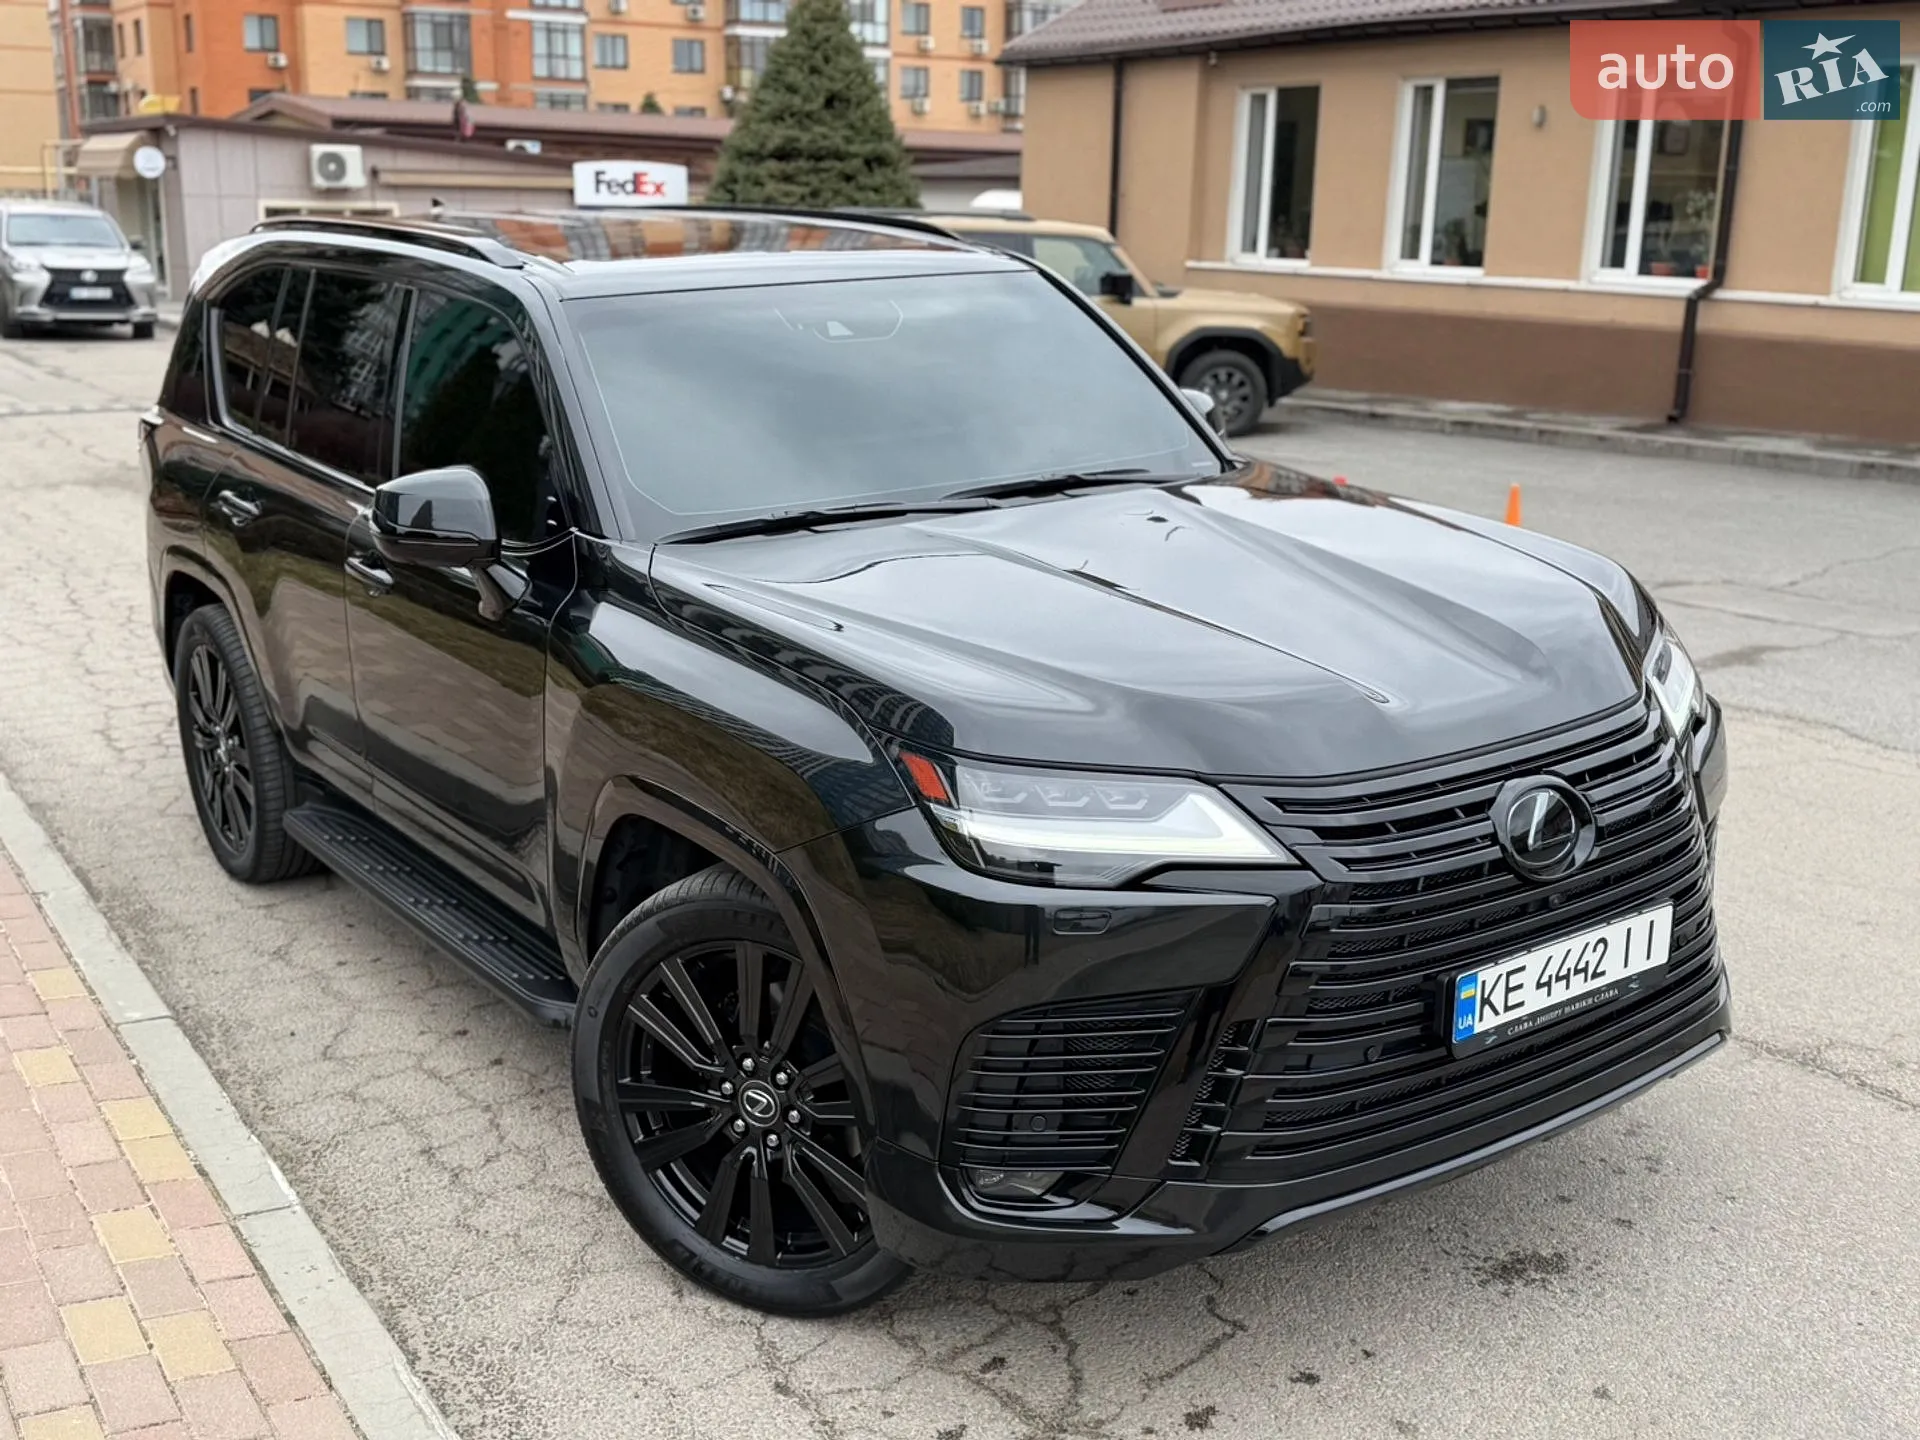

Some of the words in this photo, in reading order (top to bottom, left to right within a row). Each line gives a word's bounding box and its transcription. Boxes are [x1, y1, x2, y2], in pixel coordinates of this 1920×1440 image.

[594, 171, 666, 196] FedEx
[1478, 964, 1527, 1023] KE
[1534, 936, 1609, 998] 4442
[1458, 1013, 1474, 1030] UA
